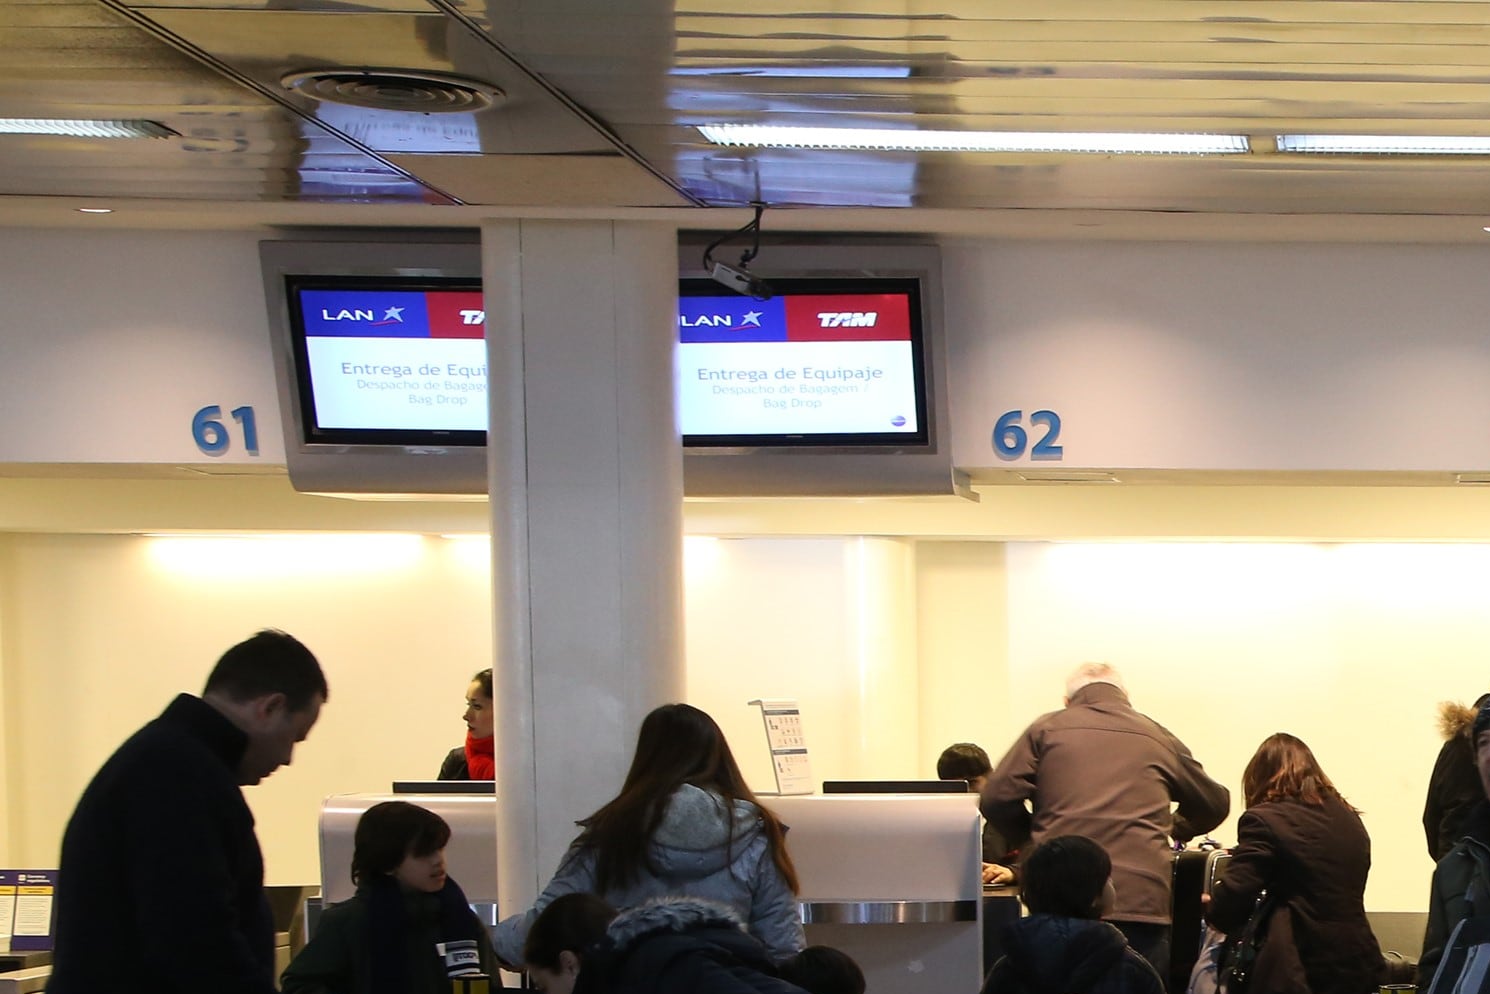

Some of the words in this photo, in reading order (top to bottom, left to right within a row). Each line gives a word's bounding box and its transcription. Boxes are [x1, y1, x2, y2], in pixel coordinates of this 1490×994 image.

[323, 309, 374, 321] LAN
[459, 310, 486, 325] TA
[681, 314, 732, 327] LAN
[817, 312, 878, 327] TAM
[340, 362, 412, 378] Entrega
[418, 363, 441, 376] de
[447, 364, 487, 379] Equi
[697, 368, 768, 382] Entrega
[774, 367, 797, 380] de
[803, 367, 883, 382] Equipaje
[356, 379, 420, 390] Despacho
[424, 381, 441, 391] de
[712, 384, 775, 396] Despacho
[779, 384, 795, 394] de
[800, 384, 859, 396] Bagagem
[408, 394, 433, 406] Bag
[437, 395, 468, 406] Drop
[763, 398, 788, 409] Bag
[791, 398, 823, 409] Drop
[191, 404, 258, 455] 61
[993, 410, 1062, 459] 62
